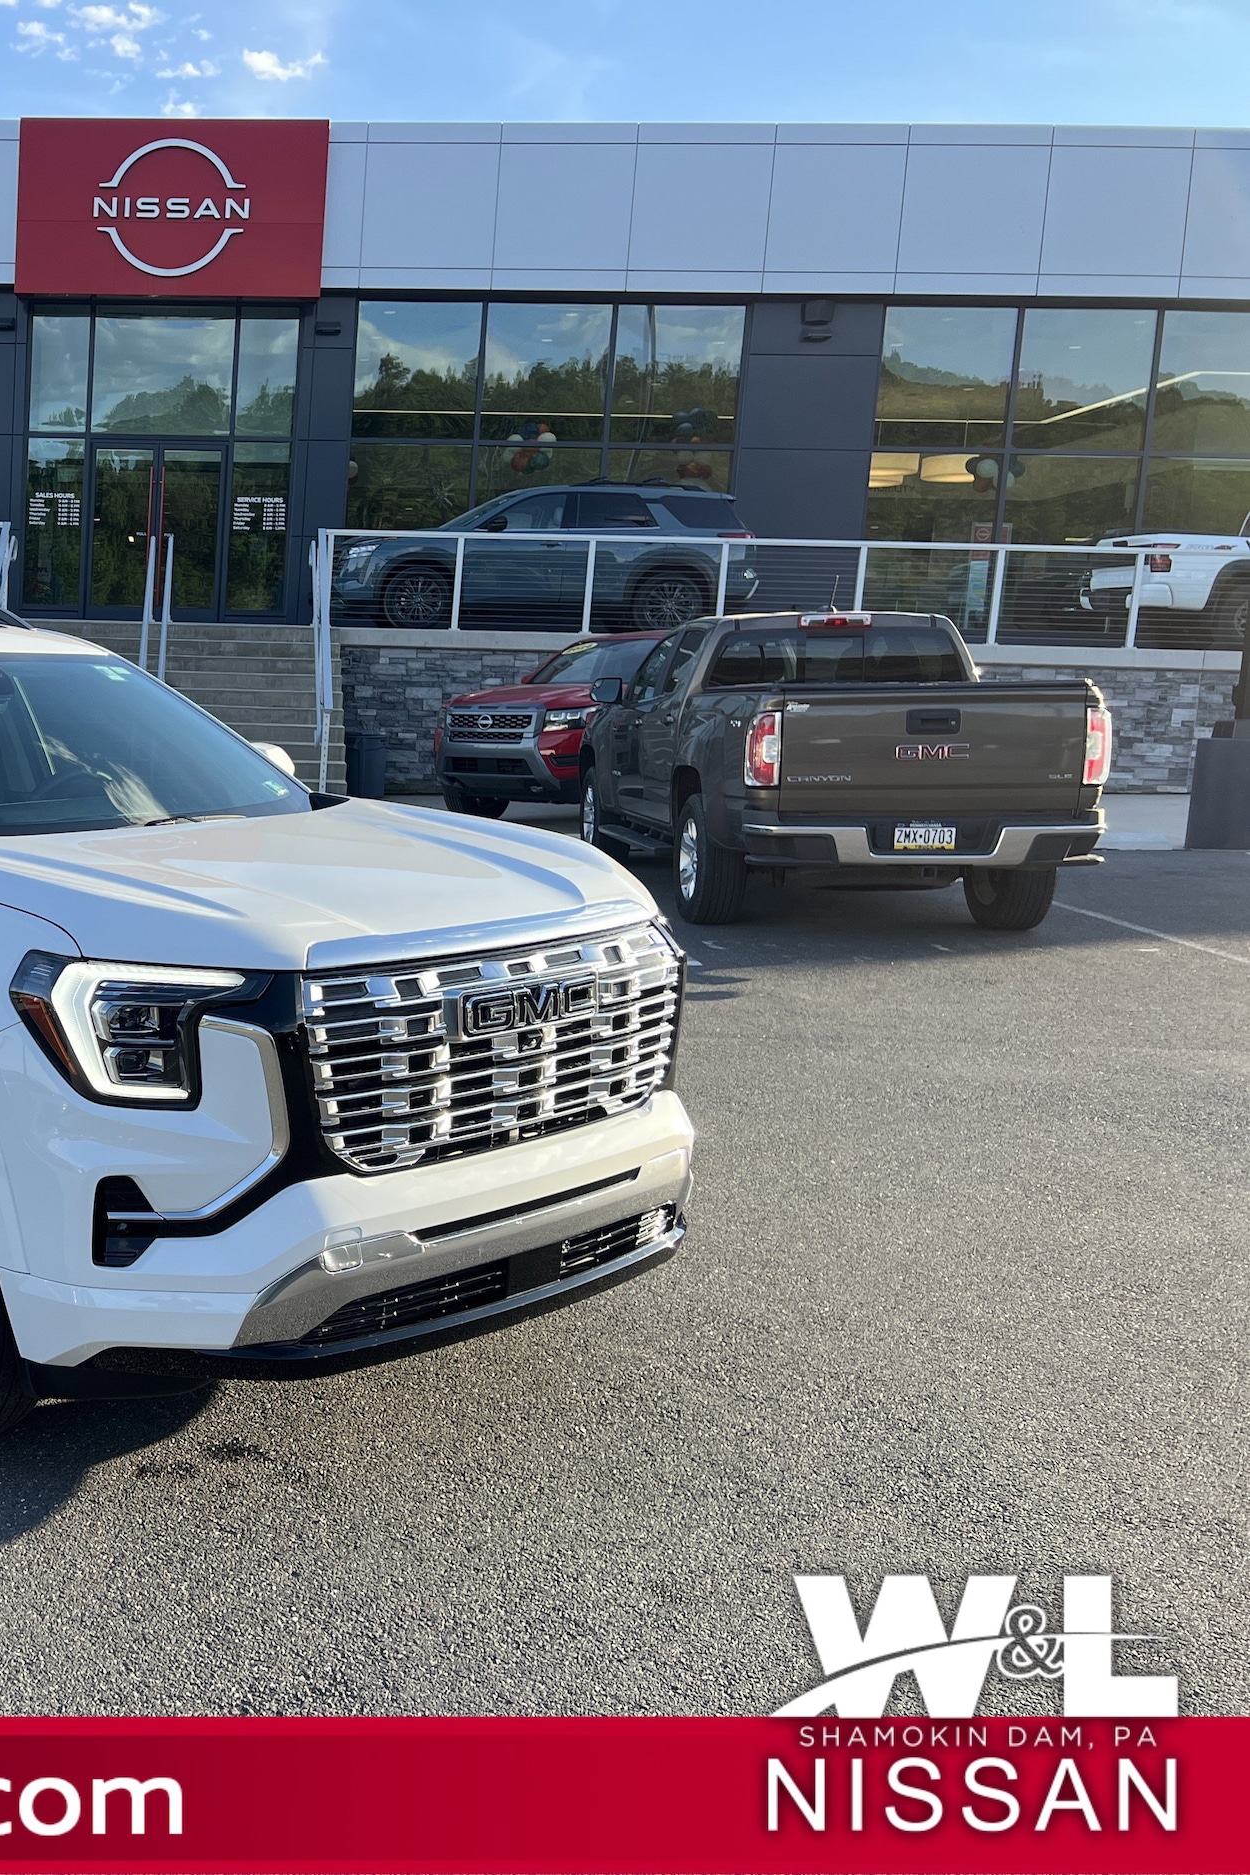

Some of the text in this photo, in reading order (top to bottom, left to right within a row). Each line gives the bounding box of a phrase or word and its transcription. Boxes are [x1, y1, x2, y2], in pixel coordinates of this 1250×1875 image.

[93, 196, 250, 219] NISSAN
[896, 744, 969, 760] GMC
[465, 975, 596, 1034] GMC
